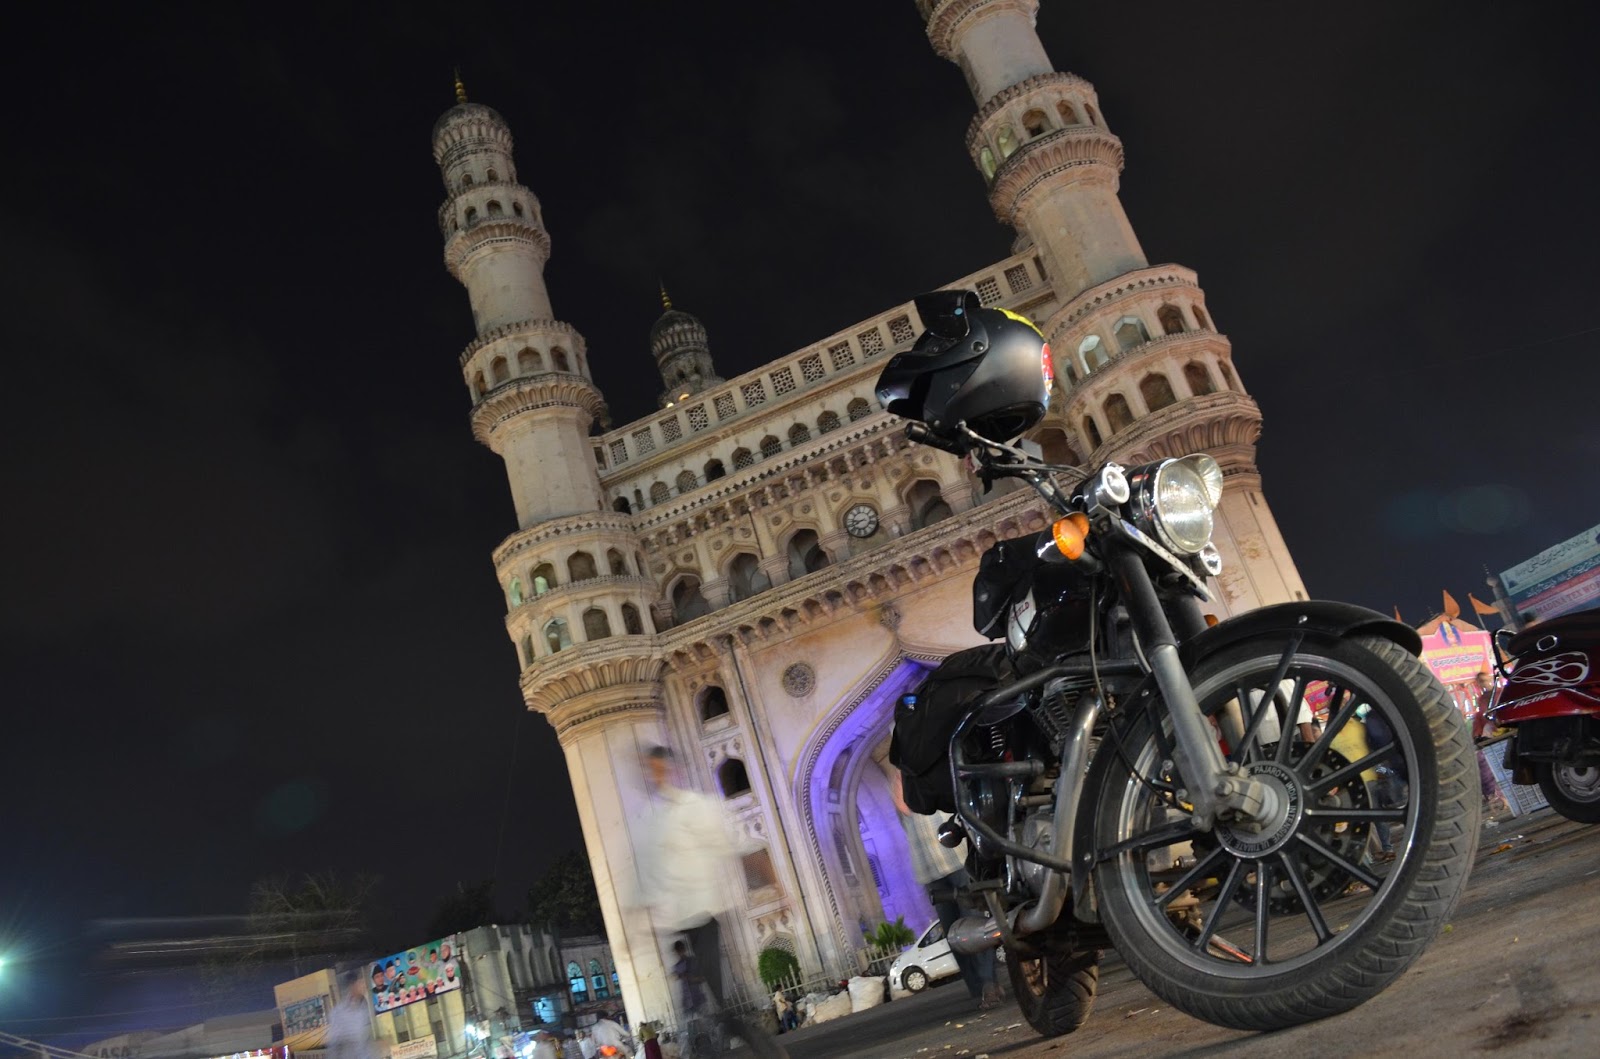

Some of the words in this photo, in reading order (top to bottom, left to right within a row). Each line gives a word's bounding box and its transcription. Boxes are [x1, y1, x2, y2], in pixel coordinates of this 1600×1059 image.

[1285, 781, 1297, 802] INDIA
[1272, 805, 1297, 844] INTENSIVE
[1235, 841, 1270, 852] ULTIMATE
